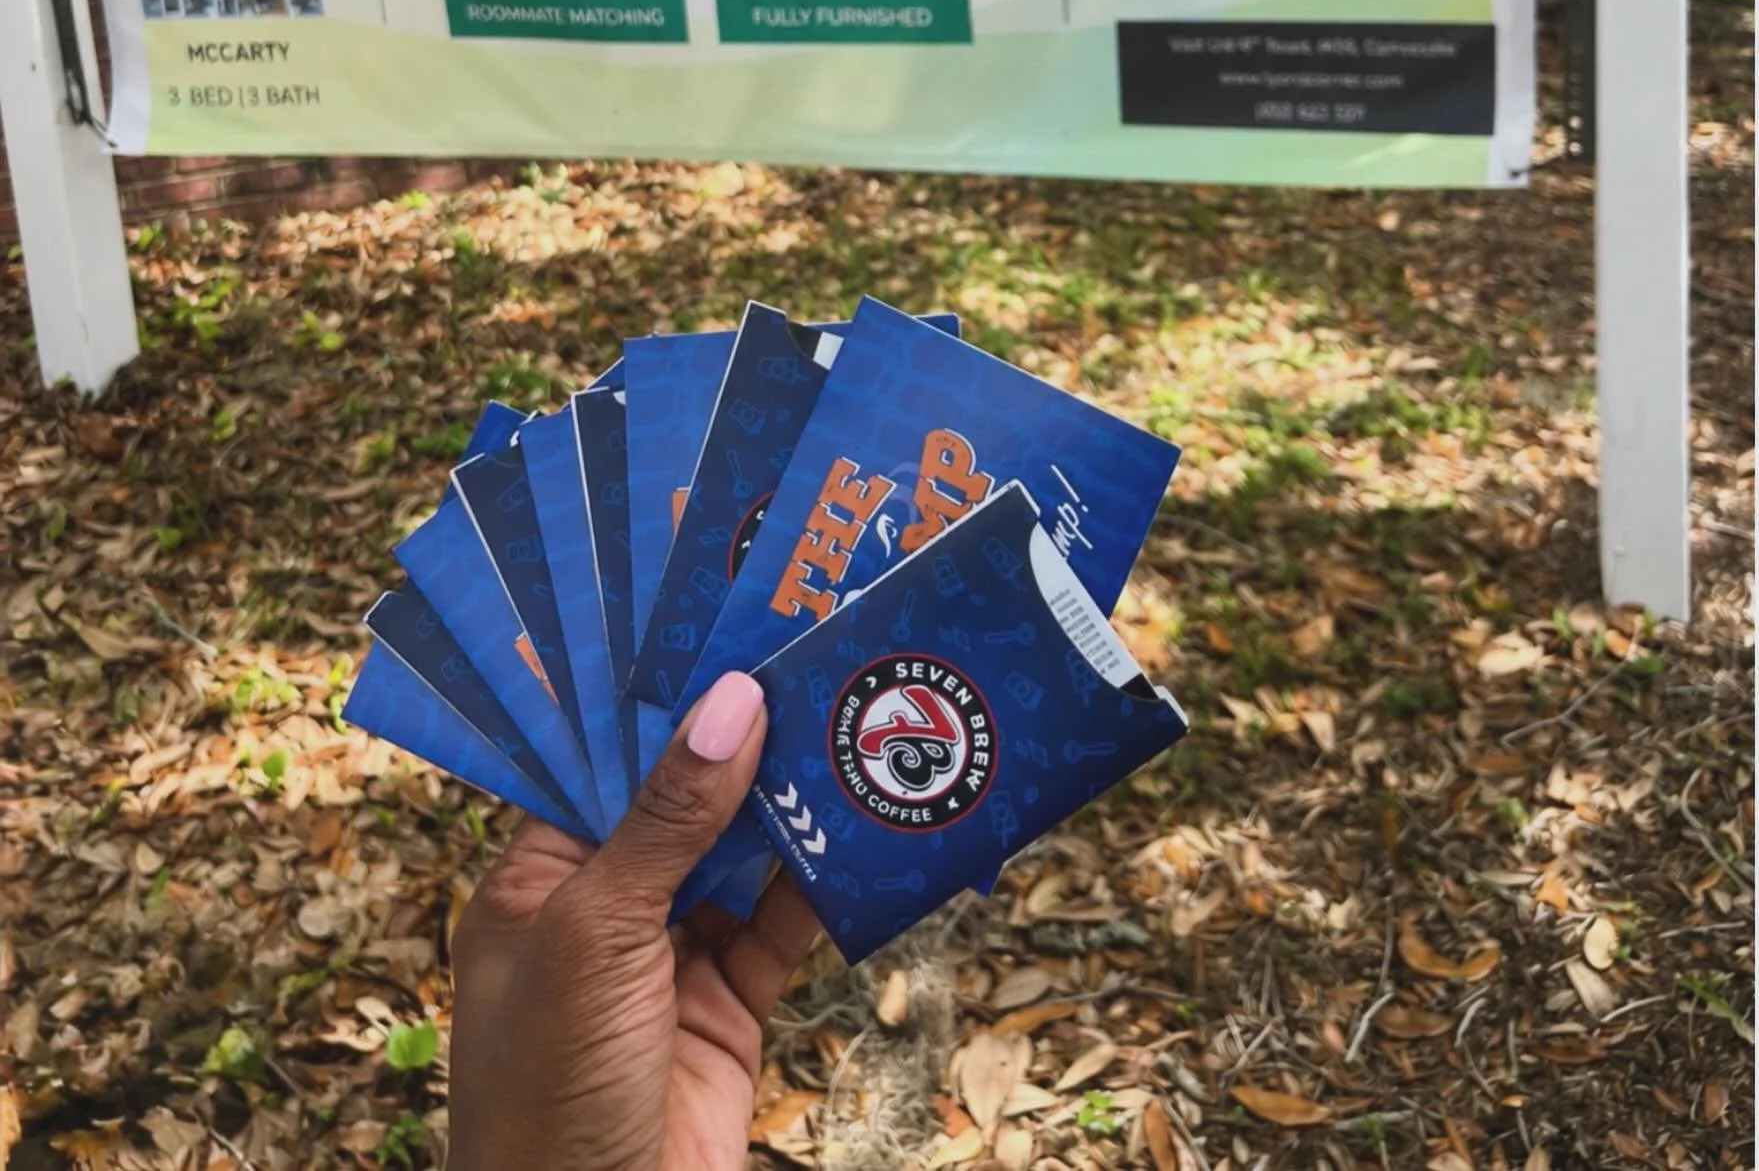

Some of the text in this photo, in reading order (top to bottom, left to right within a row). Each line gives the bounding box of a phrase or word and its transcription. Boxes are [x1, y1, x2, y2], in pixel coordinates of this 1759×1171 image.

[467, 3, 666, 26] ROOMMATE MATCHING
[752, 5, 934, 28] FULLY FURNISHED
[187, 41, 291, 64] MCCARTY
[266, 85, 322, 106] BATH
[769, 456, 897, 623] THE
[895, 661, 991, 793] SEVEN BREW
[867, 793, 934, 823] COFFEE
